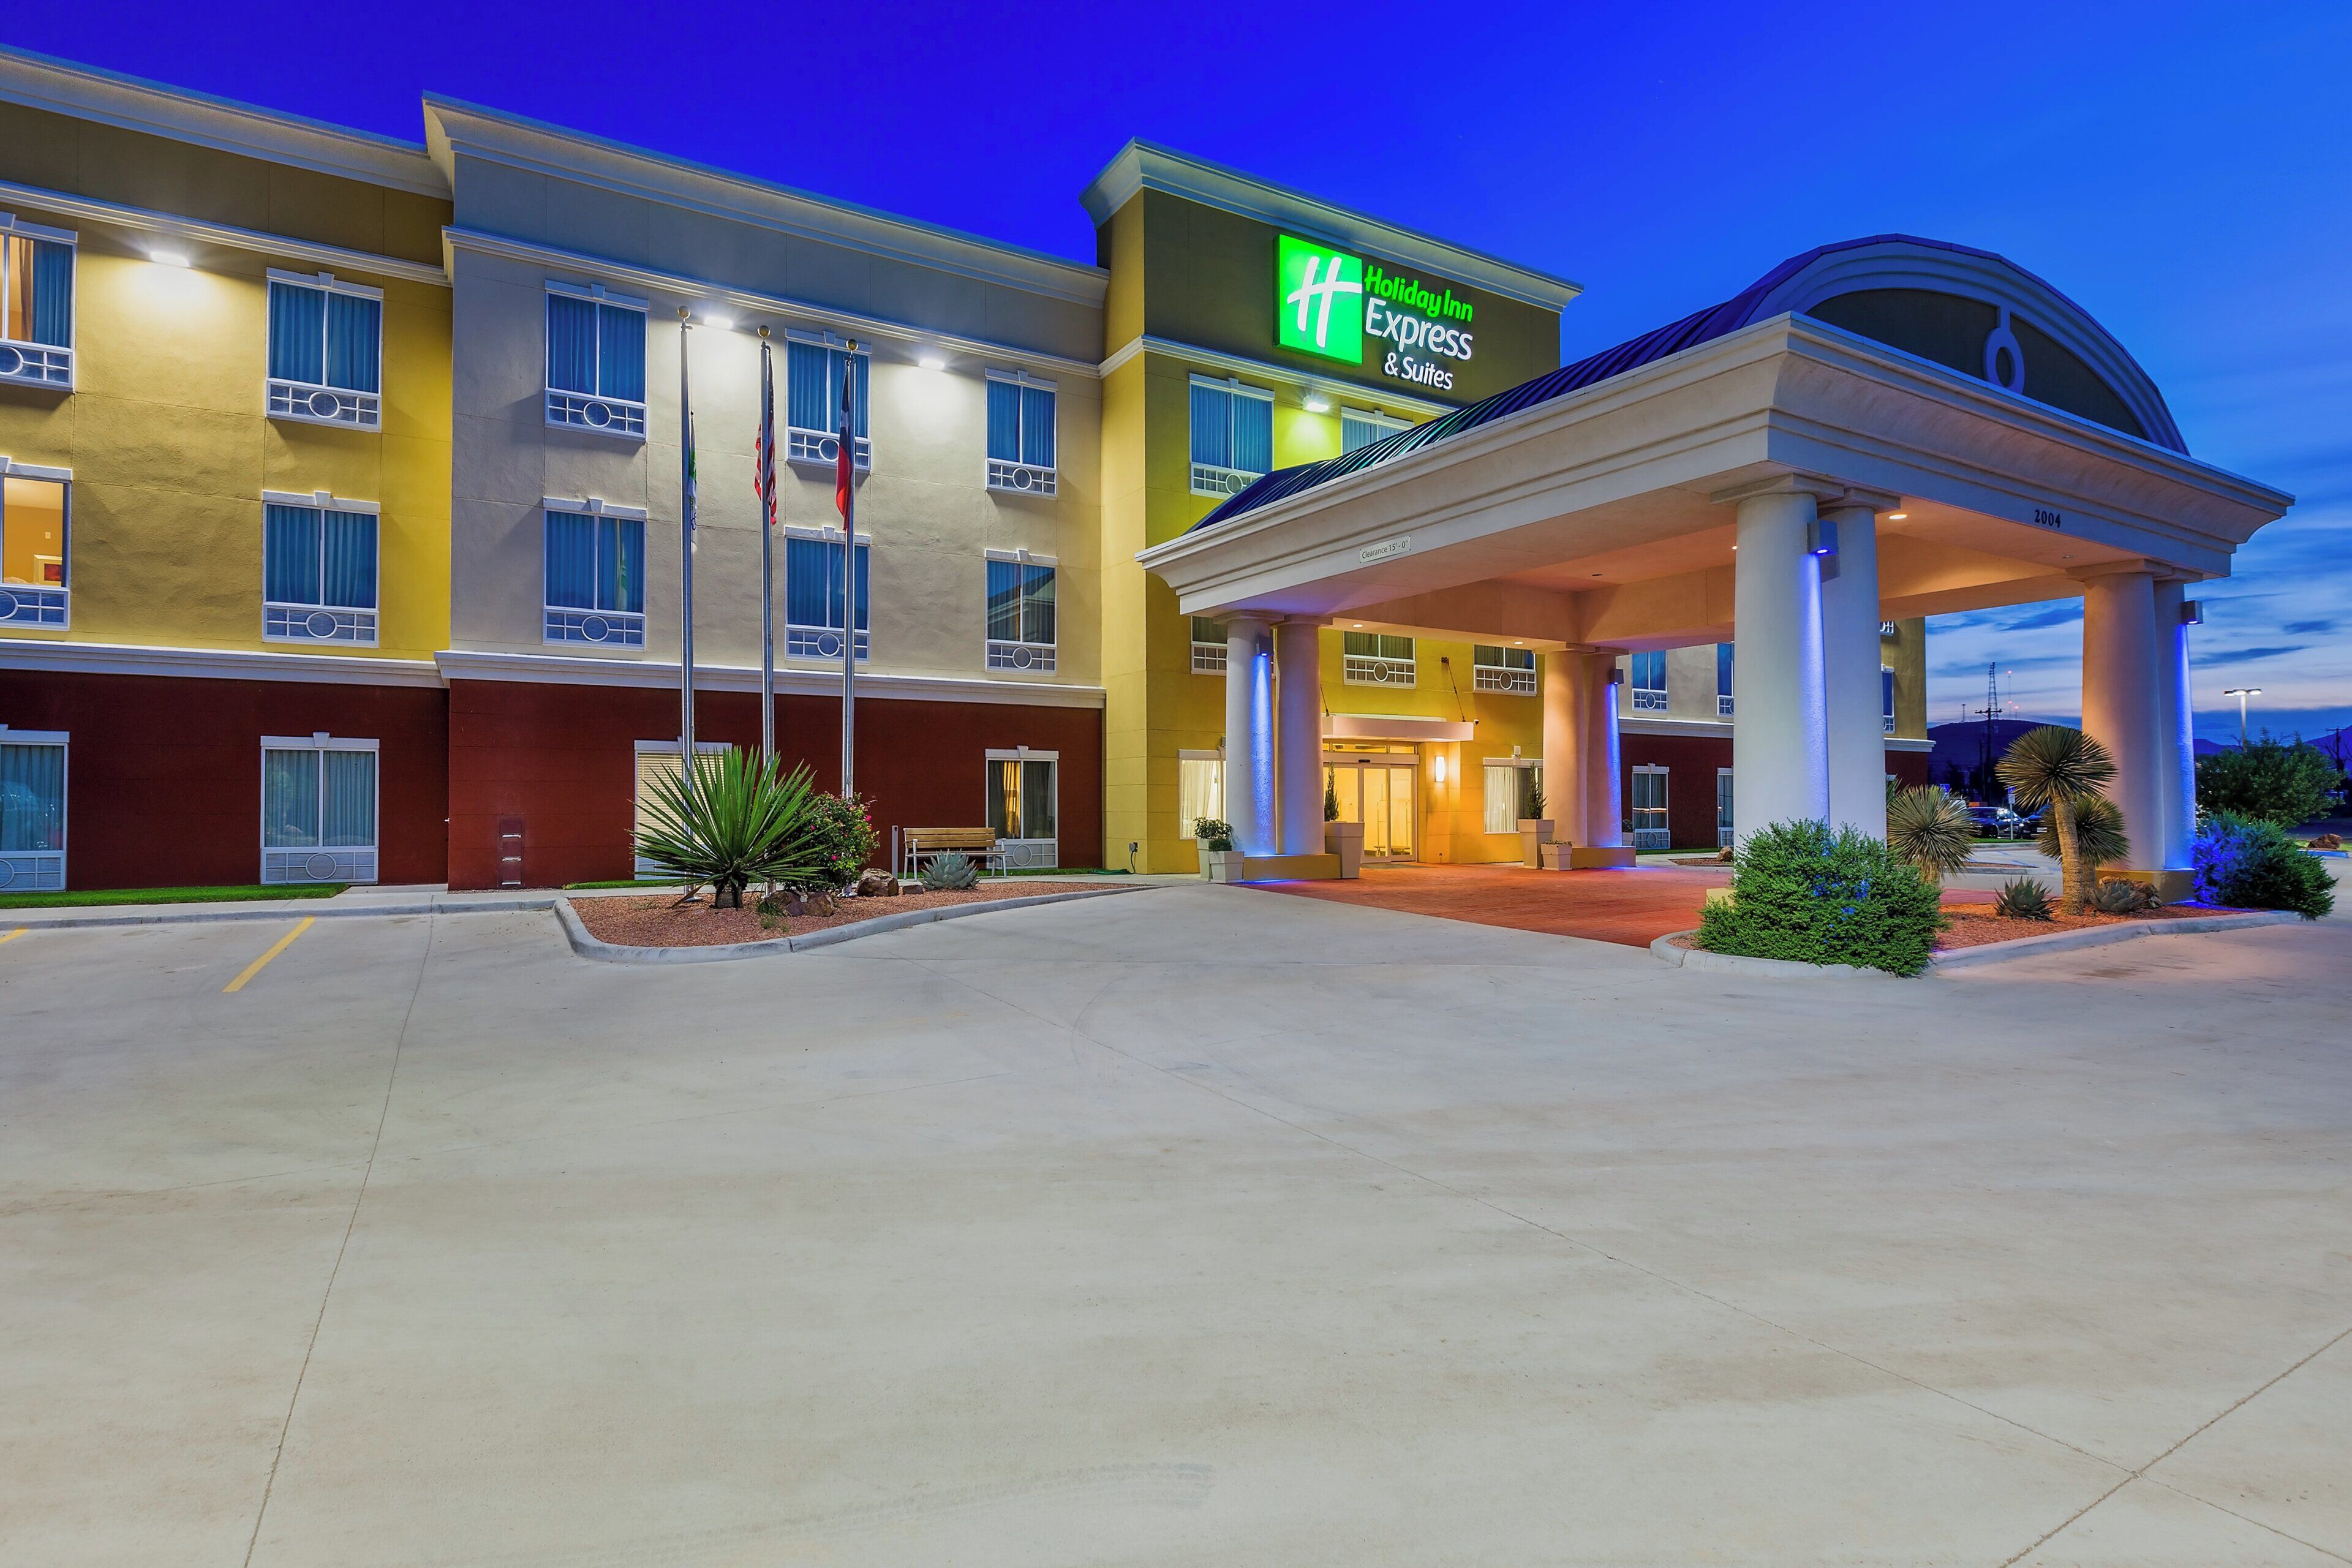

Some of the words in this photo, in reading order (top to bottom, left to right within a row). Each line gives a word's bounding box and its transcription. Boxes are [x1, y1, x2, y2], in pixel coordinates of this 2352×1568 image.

[1364, 265, 1442, 317] Holiday
[1442, 289, 1473, 322] Inn
[1365, 297, 1474, 360] Express
[1384, 352, 1399, 376] &
[1401, 356, 1453, 391] Suites
[2035, 509, 2061, 528] 2004
[1362, 546, 1388, 559] Clearance
